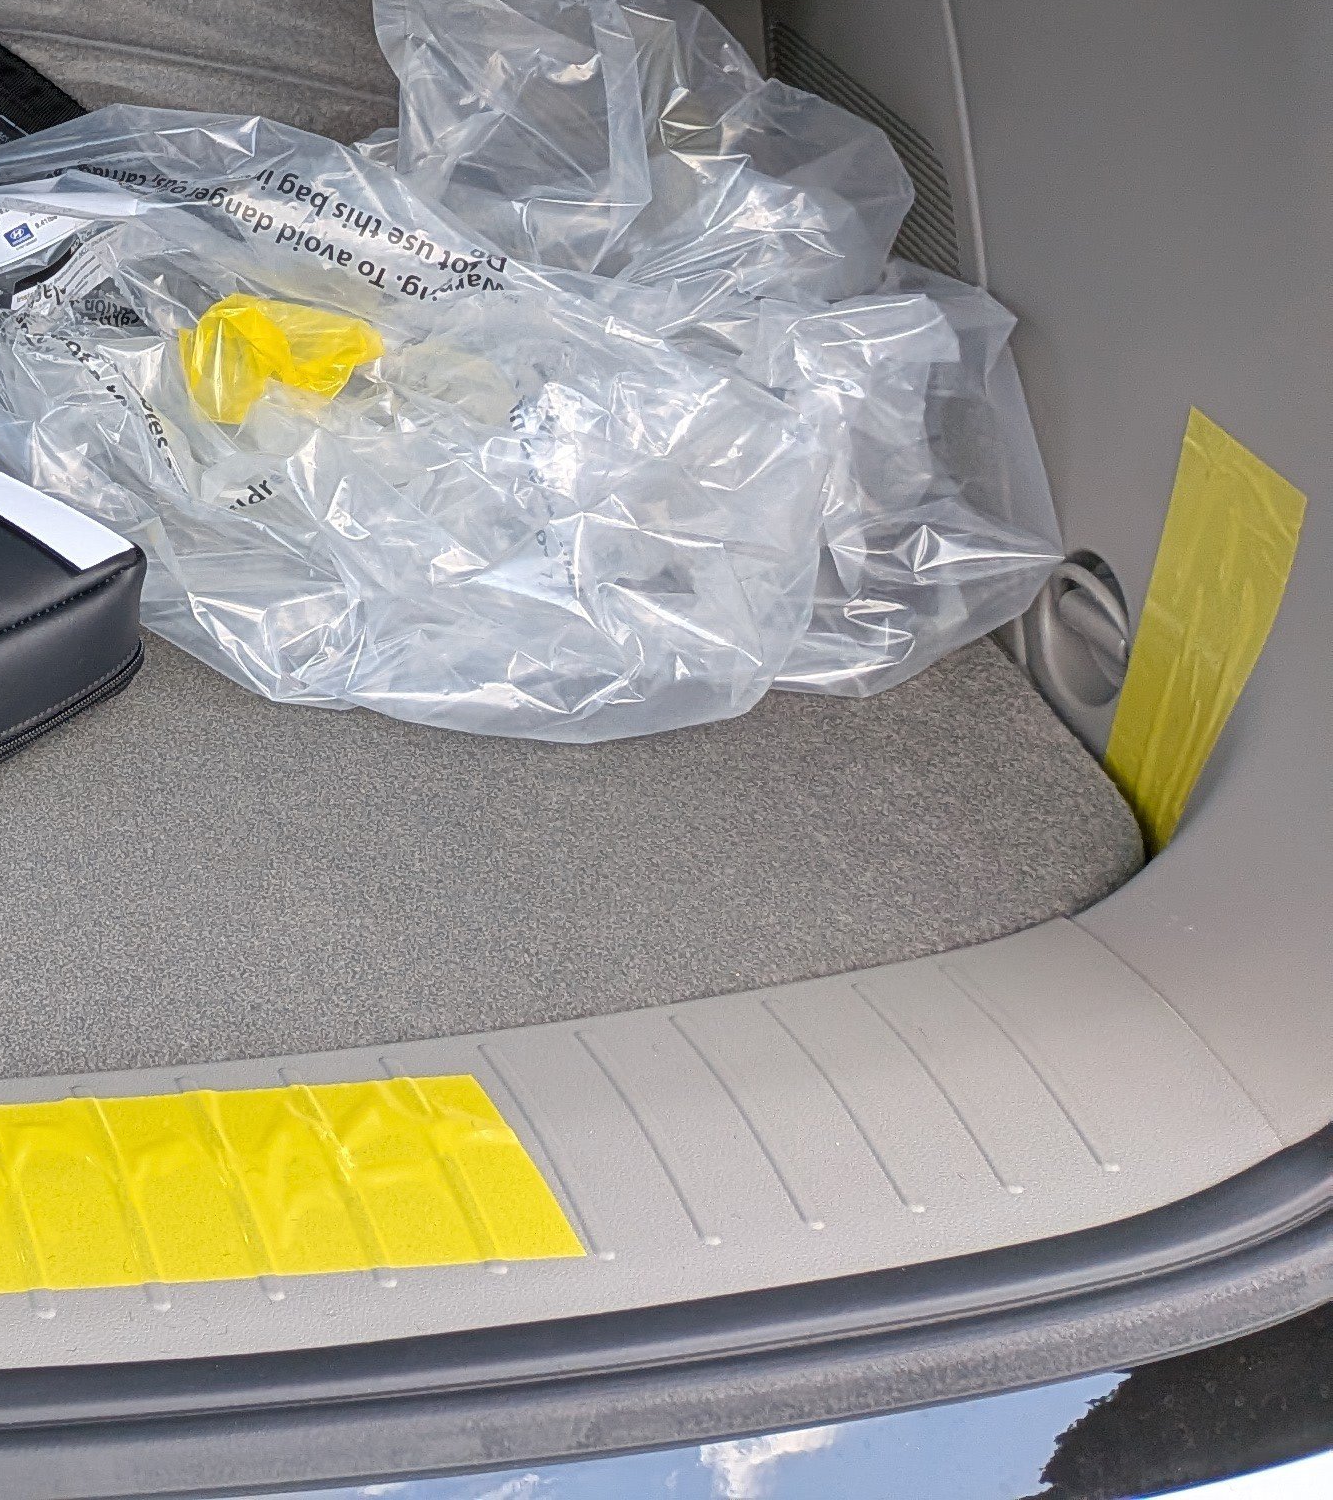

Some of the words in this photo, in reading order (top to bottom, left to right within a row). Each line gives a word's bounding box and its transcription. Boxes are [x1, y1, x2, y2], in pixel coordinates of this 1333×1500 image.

[276, 172, 330, 217] bag
[332, 201, 382, 239] this
[275, 223, 353, 266] avoid
[387, 226, 435, 260] use
[357, 260, 387, 289] To
